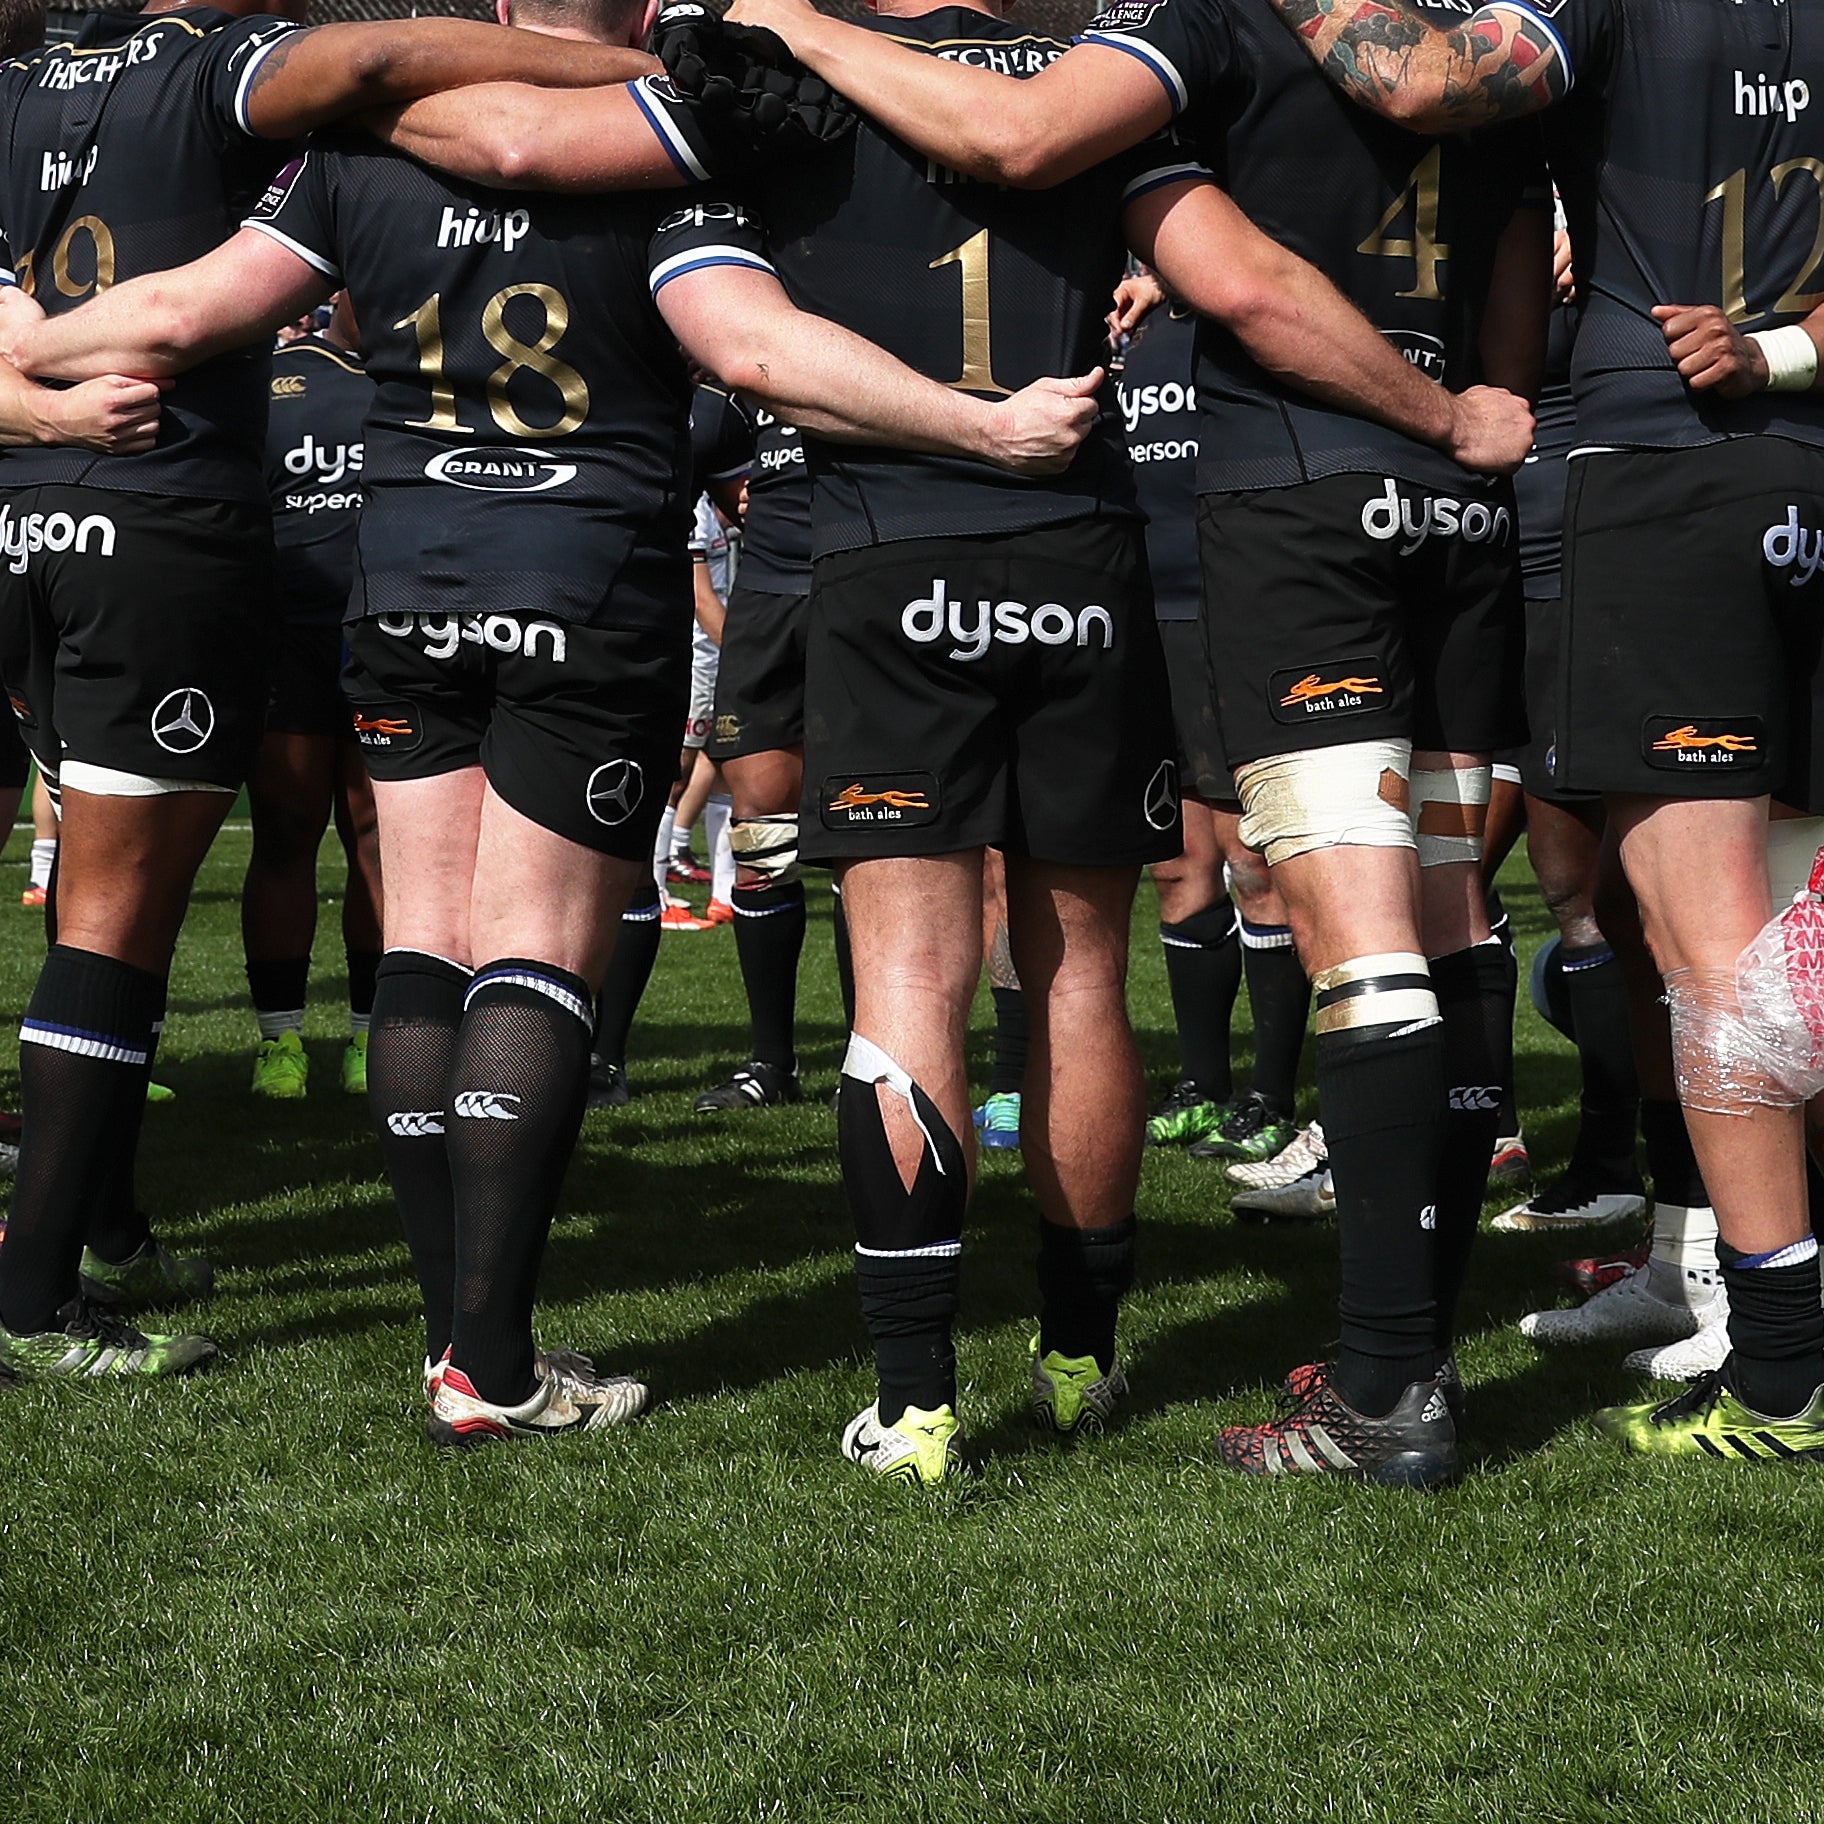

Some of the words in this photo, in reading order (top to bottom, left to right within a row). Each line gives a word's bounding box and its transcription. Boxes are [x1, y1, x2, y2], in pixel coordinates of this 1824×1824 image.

[39, 33, 165, 91] THTCHRS
[926, 47, 1064, 75] TCHRS
[1356, 144, 1450, 302] 4
[928, 227, 1017, 397] 1
[392, 282, 590, 438] 18
[284, 435, 364, 484] dys
[444, 460, 538, 477] GRANT
[760, 446, 806, 469] supe
[1362, 478, 1510, 557] dyson
[901, 578, 1113, 662] dyson
[1305, 697, 1335, 713] bath
[1338, 693, 1362, 708] ales
[1677, 748, 1707, 763] bath
[1710, 749, 1734, 764] ales
[848, 806, 874, 821] bath
[877, 805, 902, 821] ales
